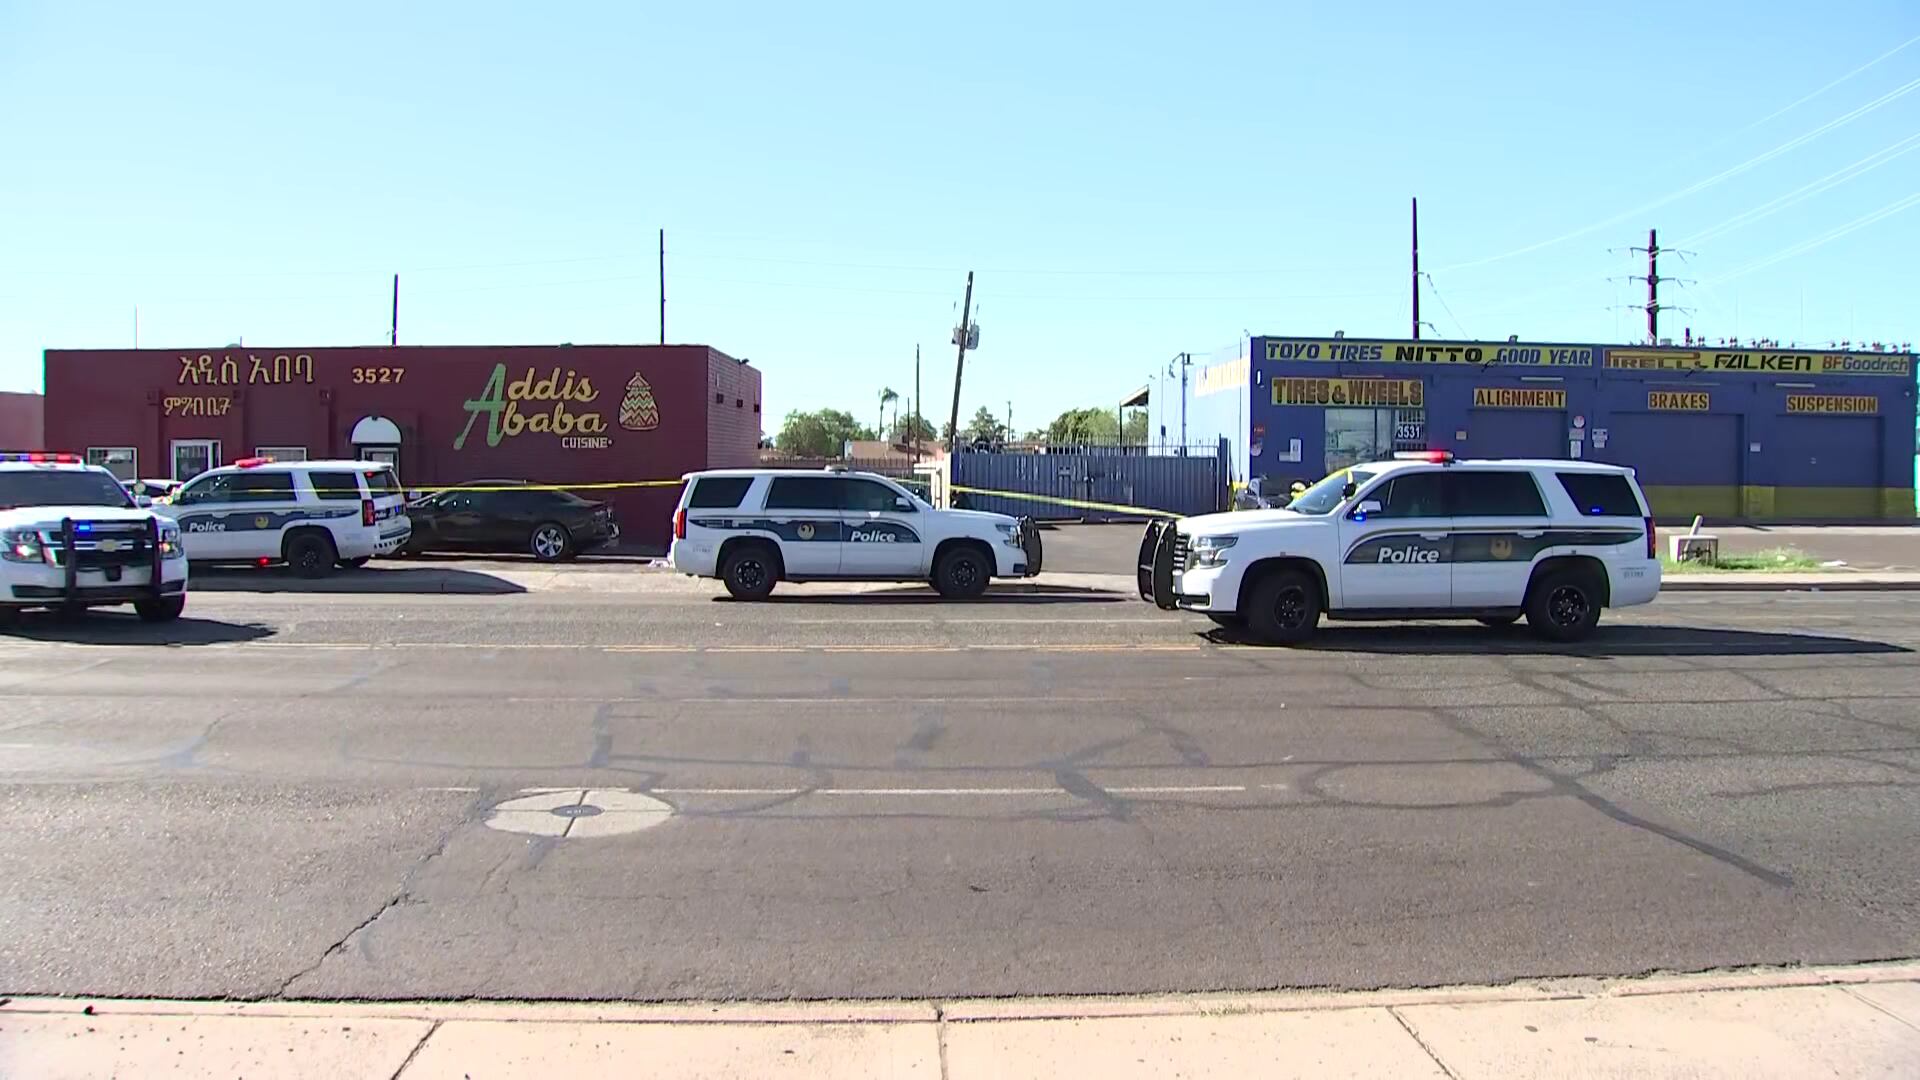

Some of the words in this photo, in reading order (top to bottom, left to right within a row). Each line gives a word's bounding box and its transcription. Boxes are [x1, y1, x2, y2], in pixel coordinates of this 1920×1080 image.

[1267, 342, 1320, 359] TOYO
[1328, 344, 1383, 360] TIRES
[1395, 345, 1483, 362] NITTO
[1496, 348, 1541, 365] GOOD
[1549, 349, 1591, 366] YEAR
[1713, 354, 1812, 371] FALKEN
[1822, 355, 1908, 372] BFGoodrich
[352, 366, 405, 385] 3527
[1273, 380, 1328, 405] TIRES
[1347, 379, 1422, 406] WHEELS
[1475, 390, 1565, 407] ALIGNMENT
[1648, 393, 1708, 410] BRAKES
[1787, 395, 1877, 412] SUSPENSION
[1397, 425, 1421, 439] 3531
[188, 521, 226, 533] Police
[850, 530, 896, 543] Police
[1377, 546, 1440, 564] Police
